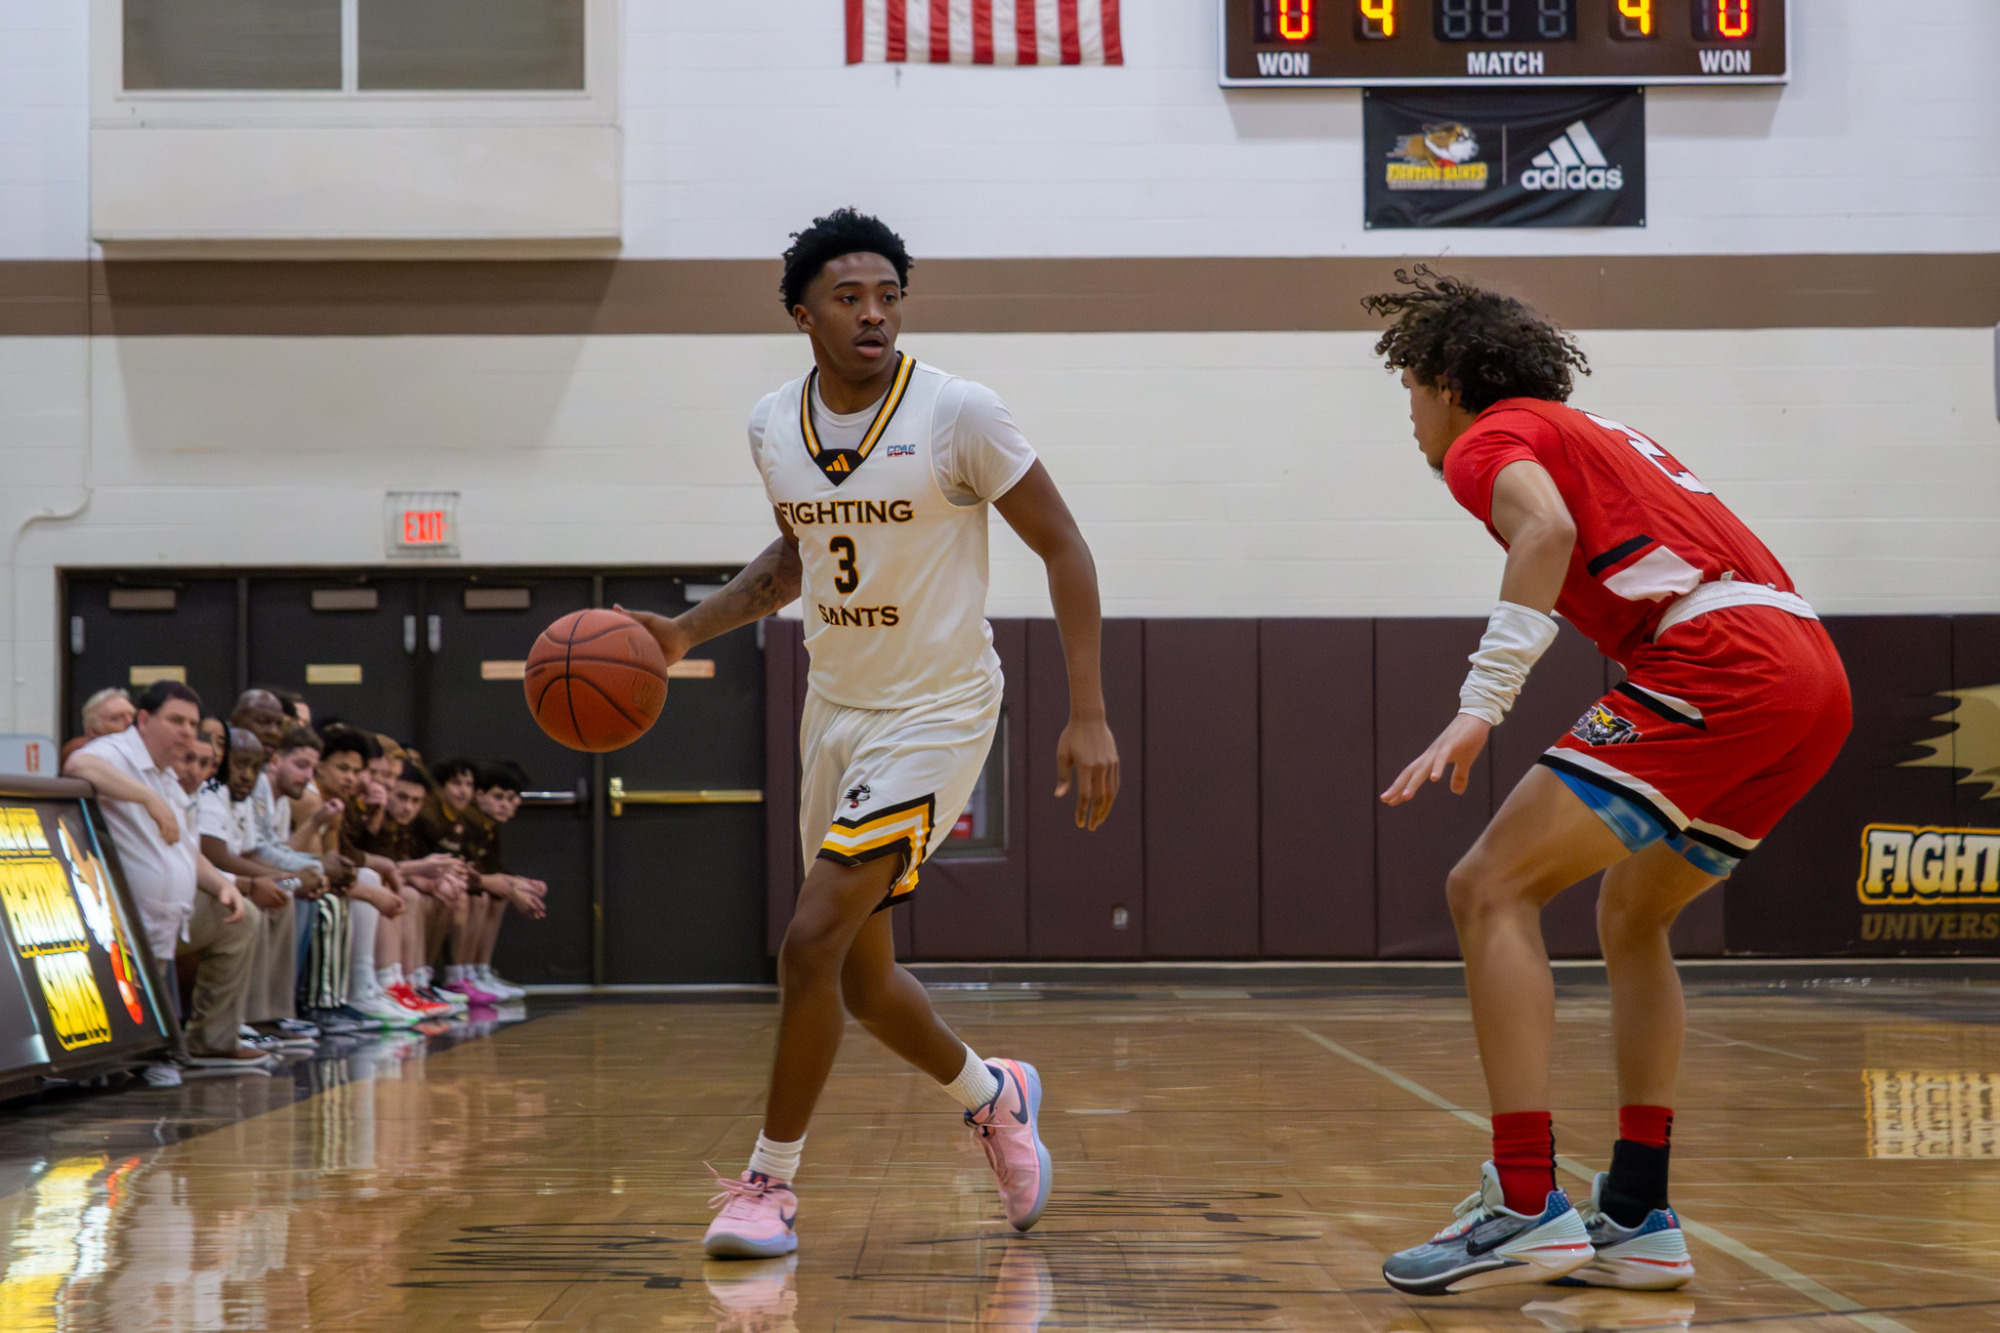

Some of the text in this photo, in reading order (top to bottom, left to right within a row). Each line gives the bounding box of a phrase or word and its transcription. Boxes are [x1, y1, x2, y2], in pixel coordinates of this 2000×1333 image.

[1257, 52, 1311, 76] WON
[1467, 51, 1545, 76] MATCH
[1699, 50, 1751, 74] WON
[1520, 164, 1624, 190] adidas
[403, 511, 445, 543] EXIT
[828, 534, 860, 596] 3
[818, 602, 900, 628] SANTS
[1861, 827, 2000, 899] FIGHT
[1861, 911, 2000, 941] UNIVERS
